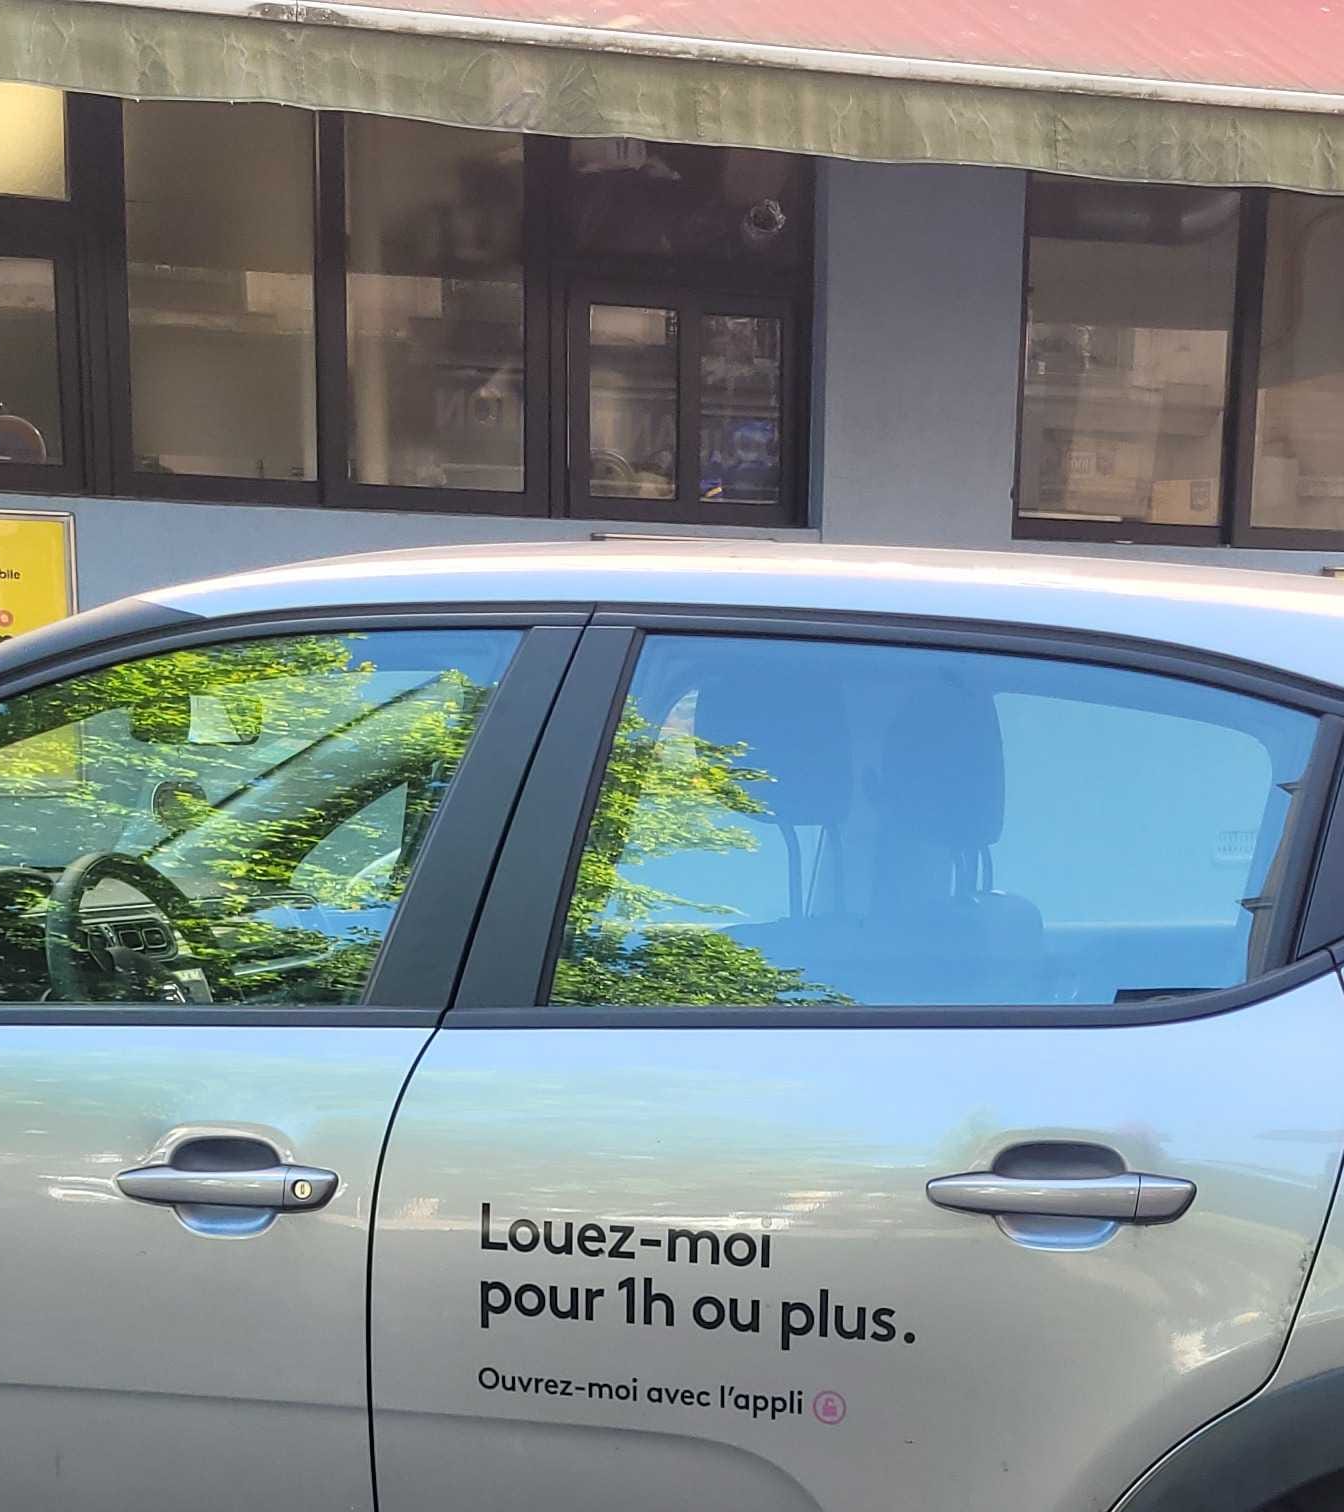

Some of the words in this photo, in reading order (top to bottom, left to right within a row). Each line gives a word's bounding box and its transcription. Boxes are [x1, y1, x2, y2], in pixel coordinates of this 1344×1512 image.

[480, 1202, 771, 1268] Louez-moi
[480, 1278, 605, 1328] pour
[618, 1276, 675, 1327] 1h
[692, 1295, 760, 1333] ou
[780, 1288, 916, 1350] plus.
[478, 1367, 638, 1402] Ouvrez-moi
[646, 1386, 711, 1408] avec
